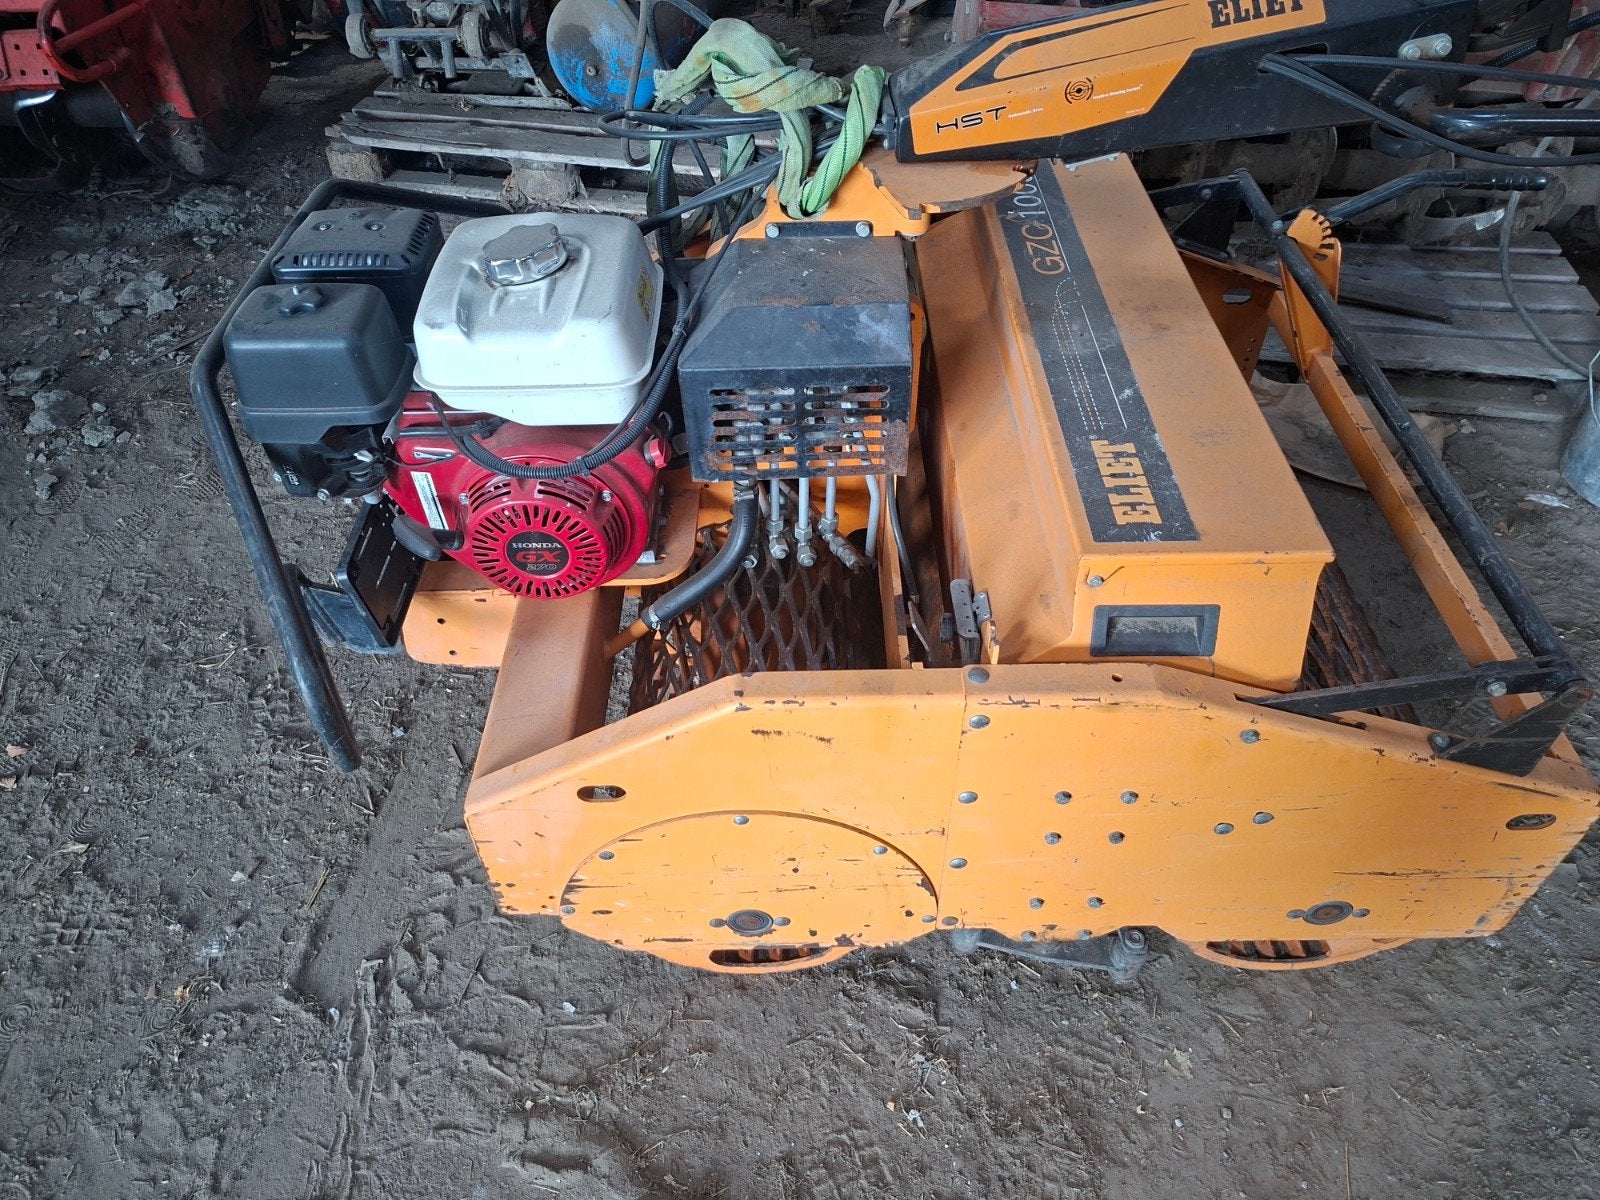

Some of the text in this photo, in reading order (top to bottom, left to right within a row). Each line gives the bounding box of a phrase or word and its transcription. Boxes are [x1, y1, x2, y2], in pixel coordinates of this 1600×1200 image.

[936, 106, 1007, 134] HST
[1012, 176, 1065, 275] GZC 100
[1091, 440, 1163, 525] ELIET
[516, 550, 562, 563] GX
[526, 563, 557, 571] 270
